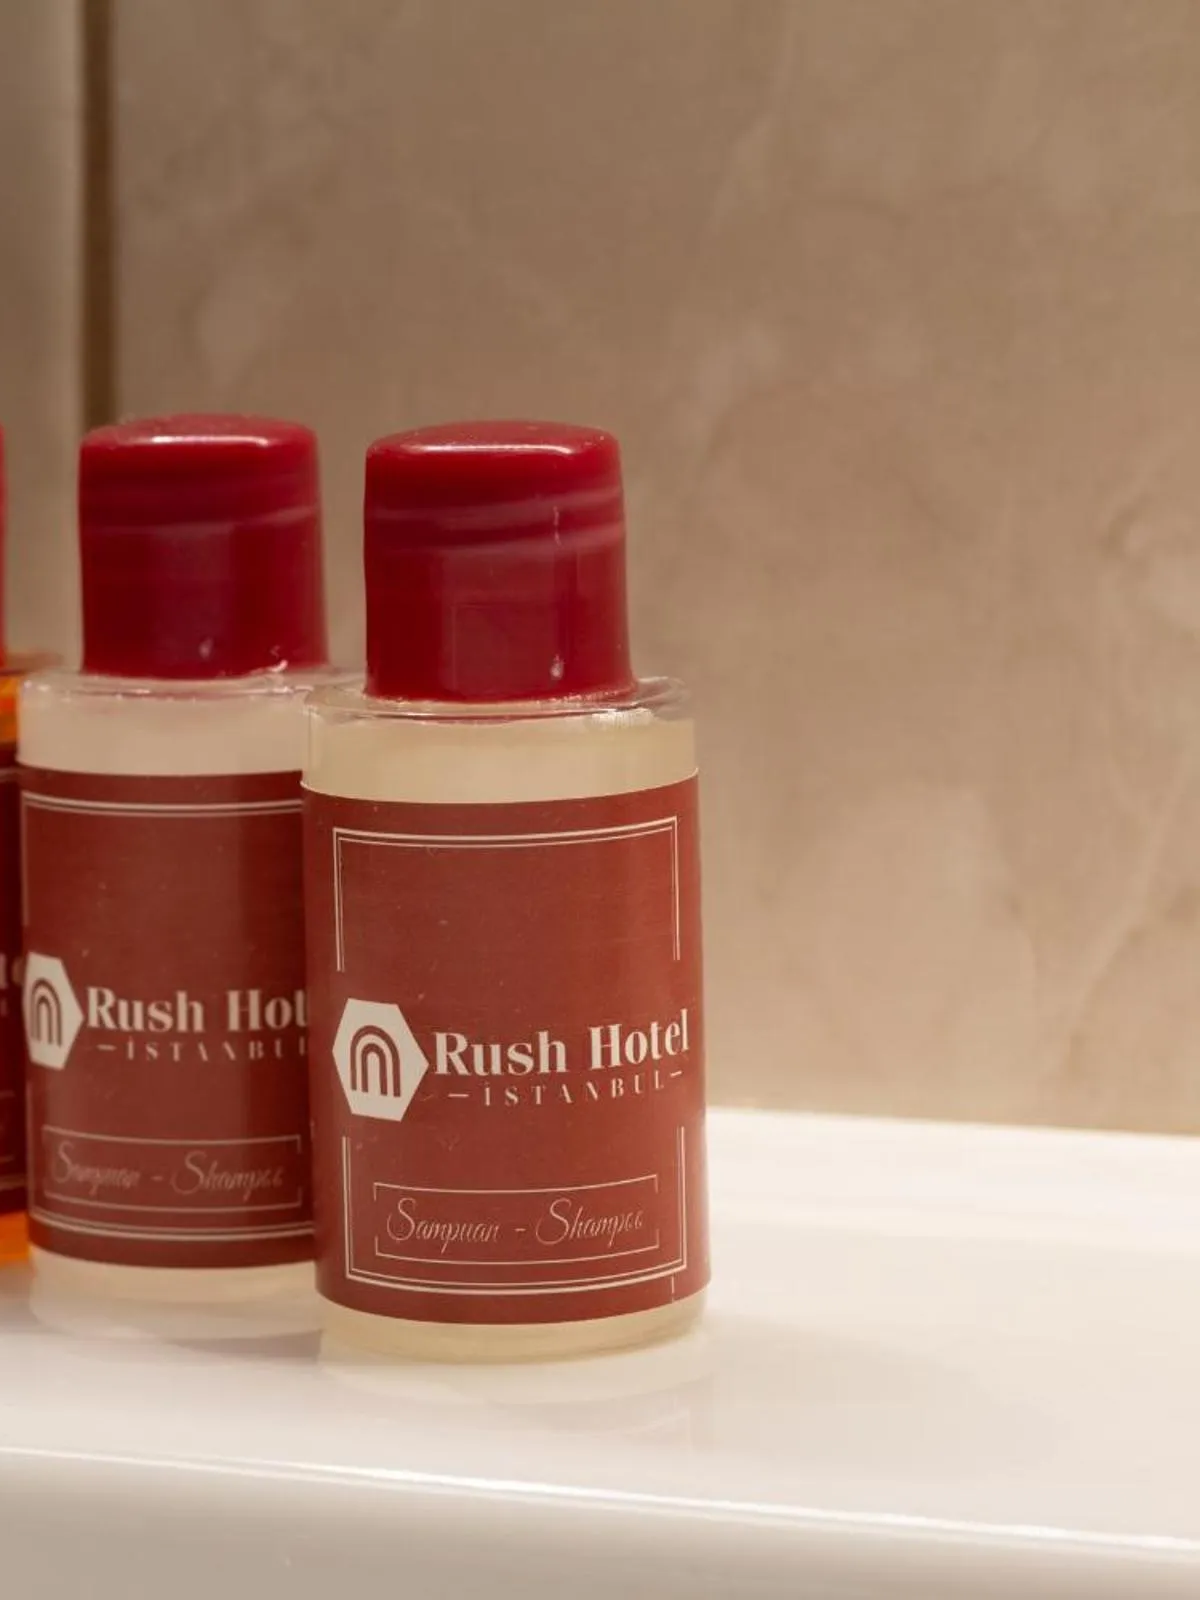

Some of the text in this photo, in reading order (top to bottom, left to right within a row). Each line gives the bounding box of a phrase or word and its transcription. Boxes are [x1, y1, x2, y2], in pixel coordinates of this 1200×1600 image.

[86, 986, 308, 1033] Rush Hot
[434, 1008, 690, 1077] Rush Hotel
